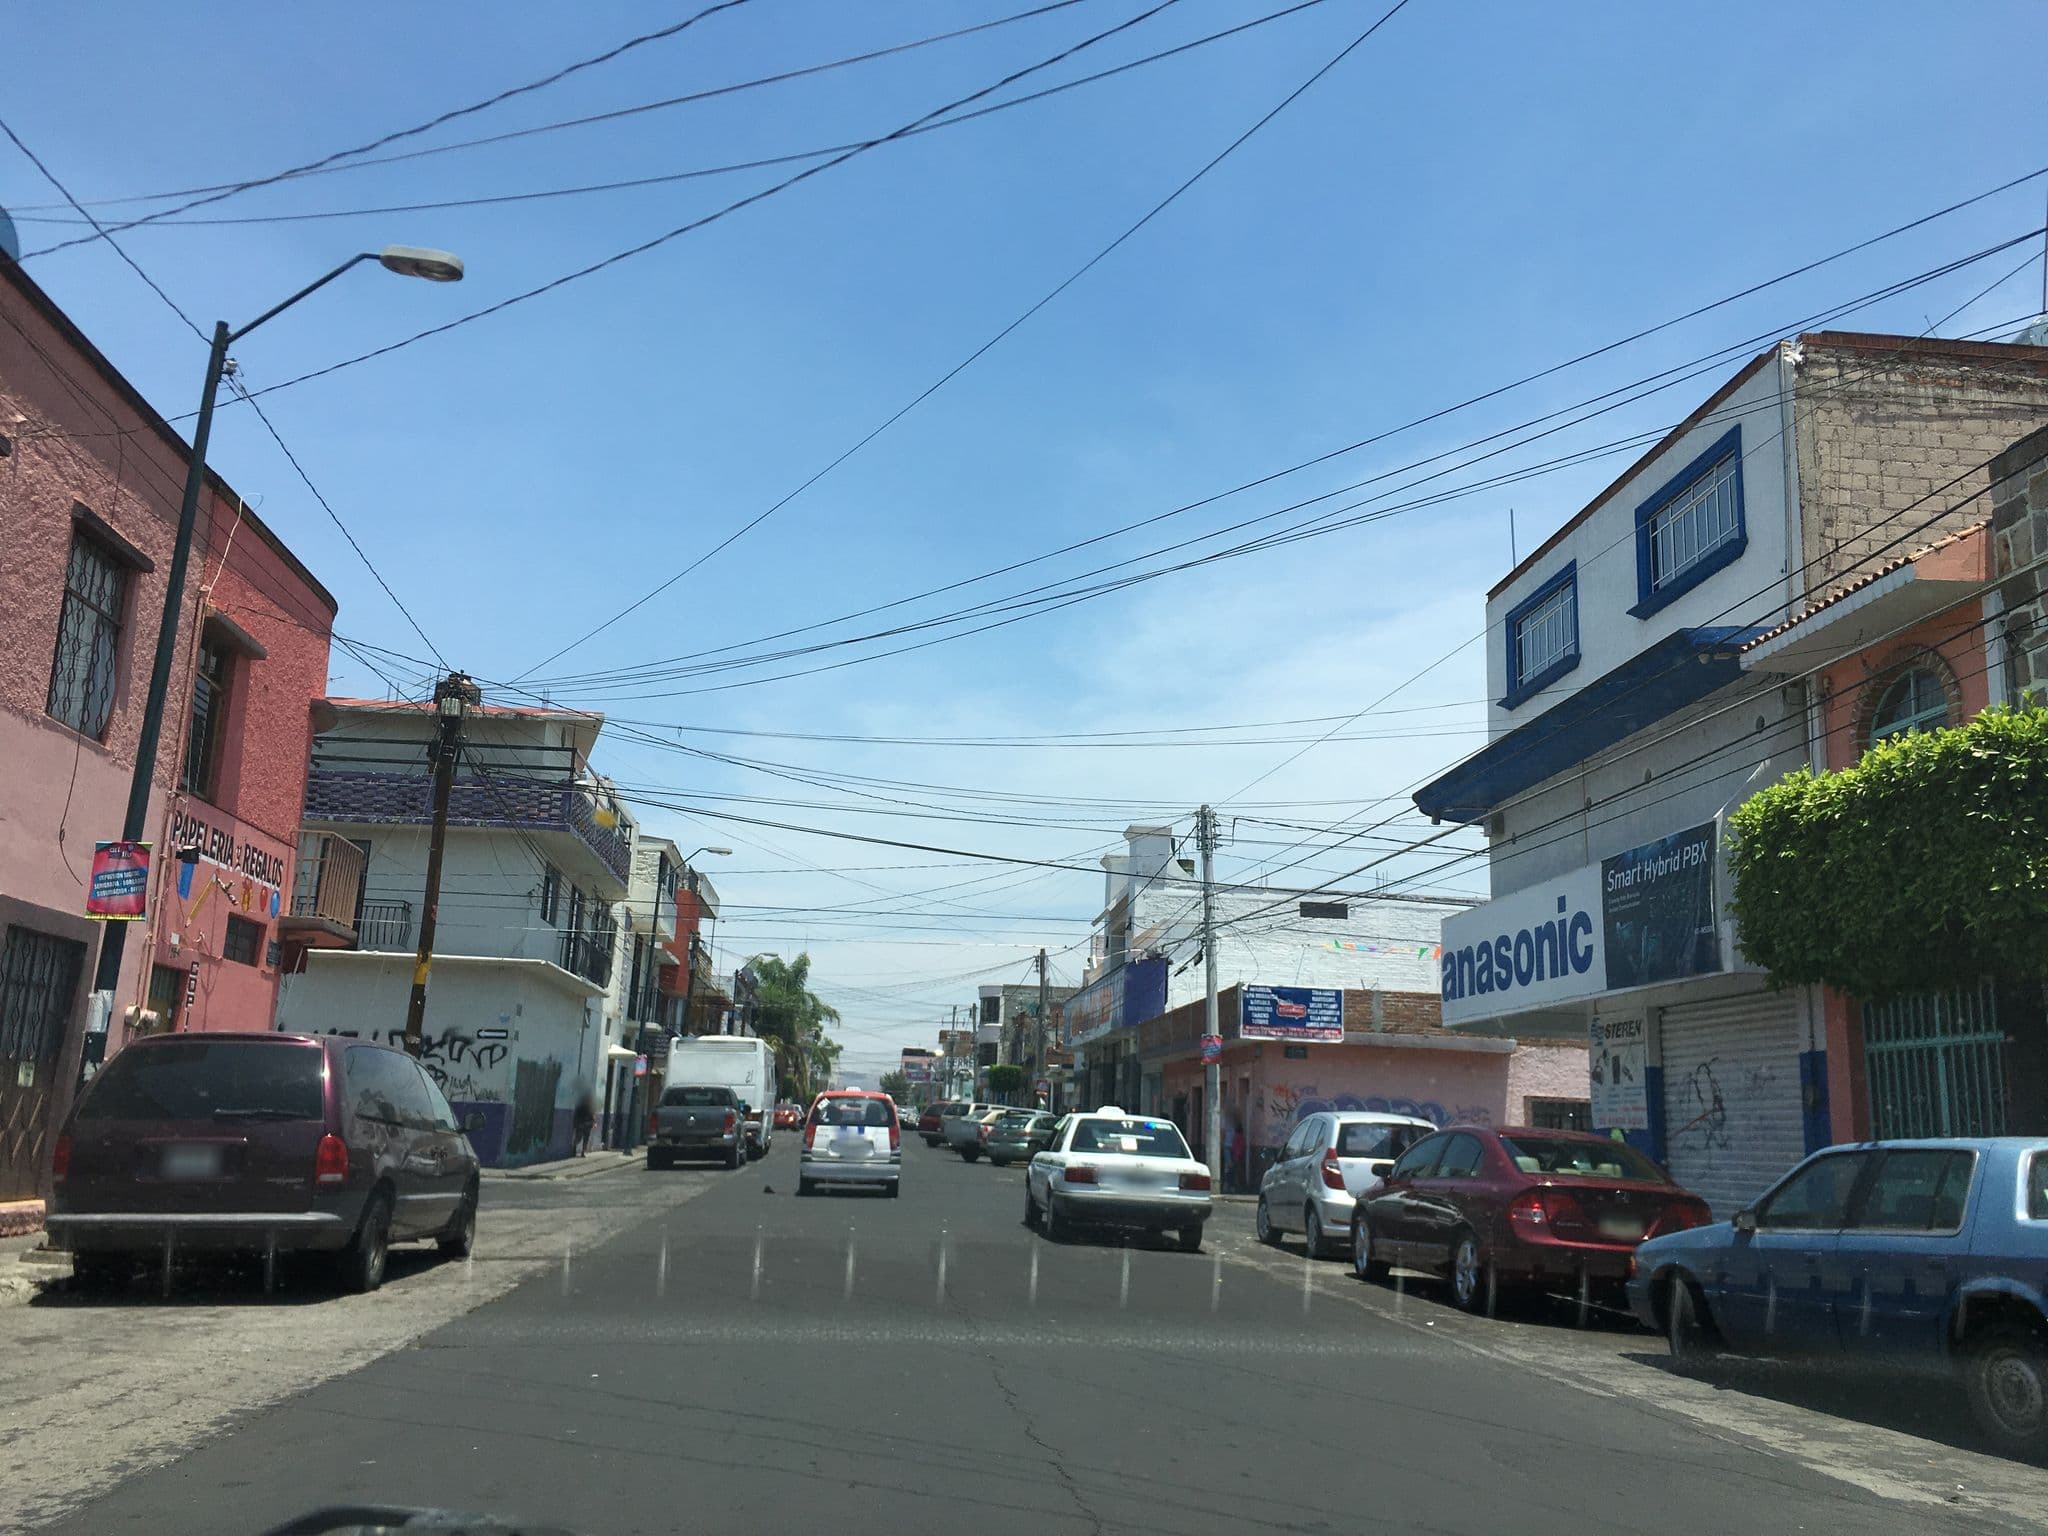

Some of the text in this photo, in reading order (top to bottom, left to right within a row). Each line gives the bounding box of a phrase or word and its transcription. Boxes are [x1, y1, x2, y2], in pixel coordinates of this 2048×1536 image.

[172, 811, 234, 869] PAPELERIA
[242, 843, 284, 888] REGALOS
[1607, 839, 1709, 893] Smart Hybrid PBX
[1441, 894, 1593, 1002] anasonic
[184, 961, 200, 1032] COPI
[1604, 1018, 1642, 1039] STEREN
[1120, 1120, 1134, 1129] 17
